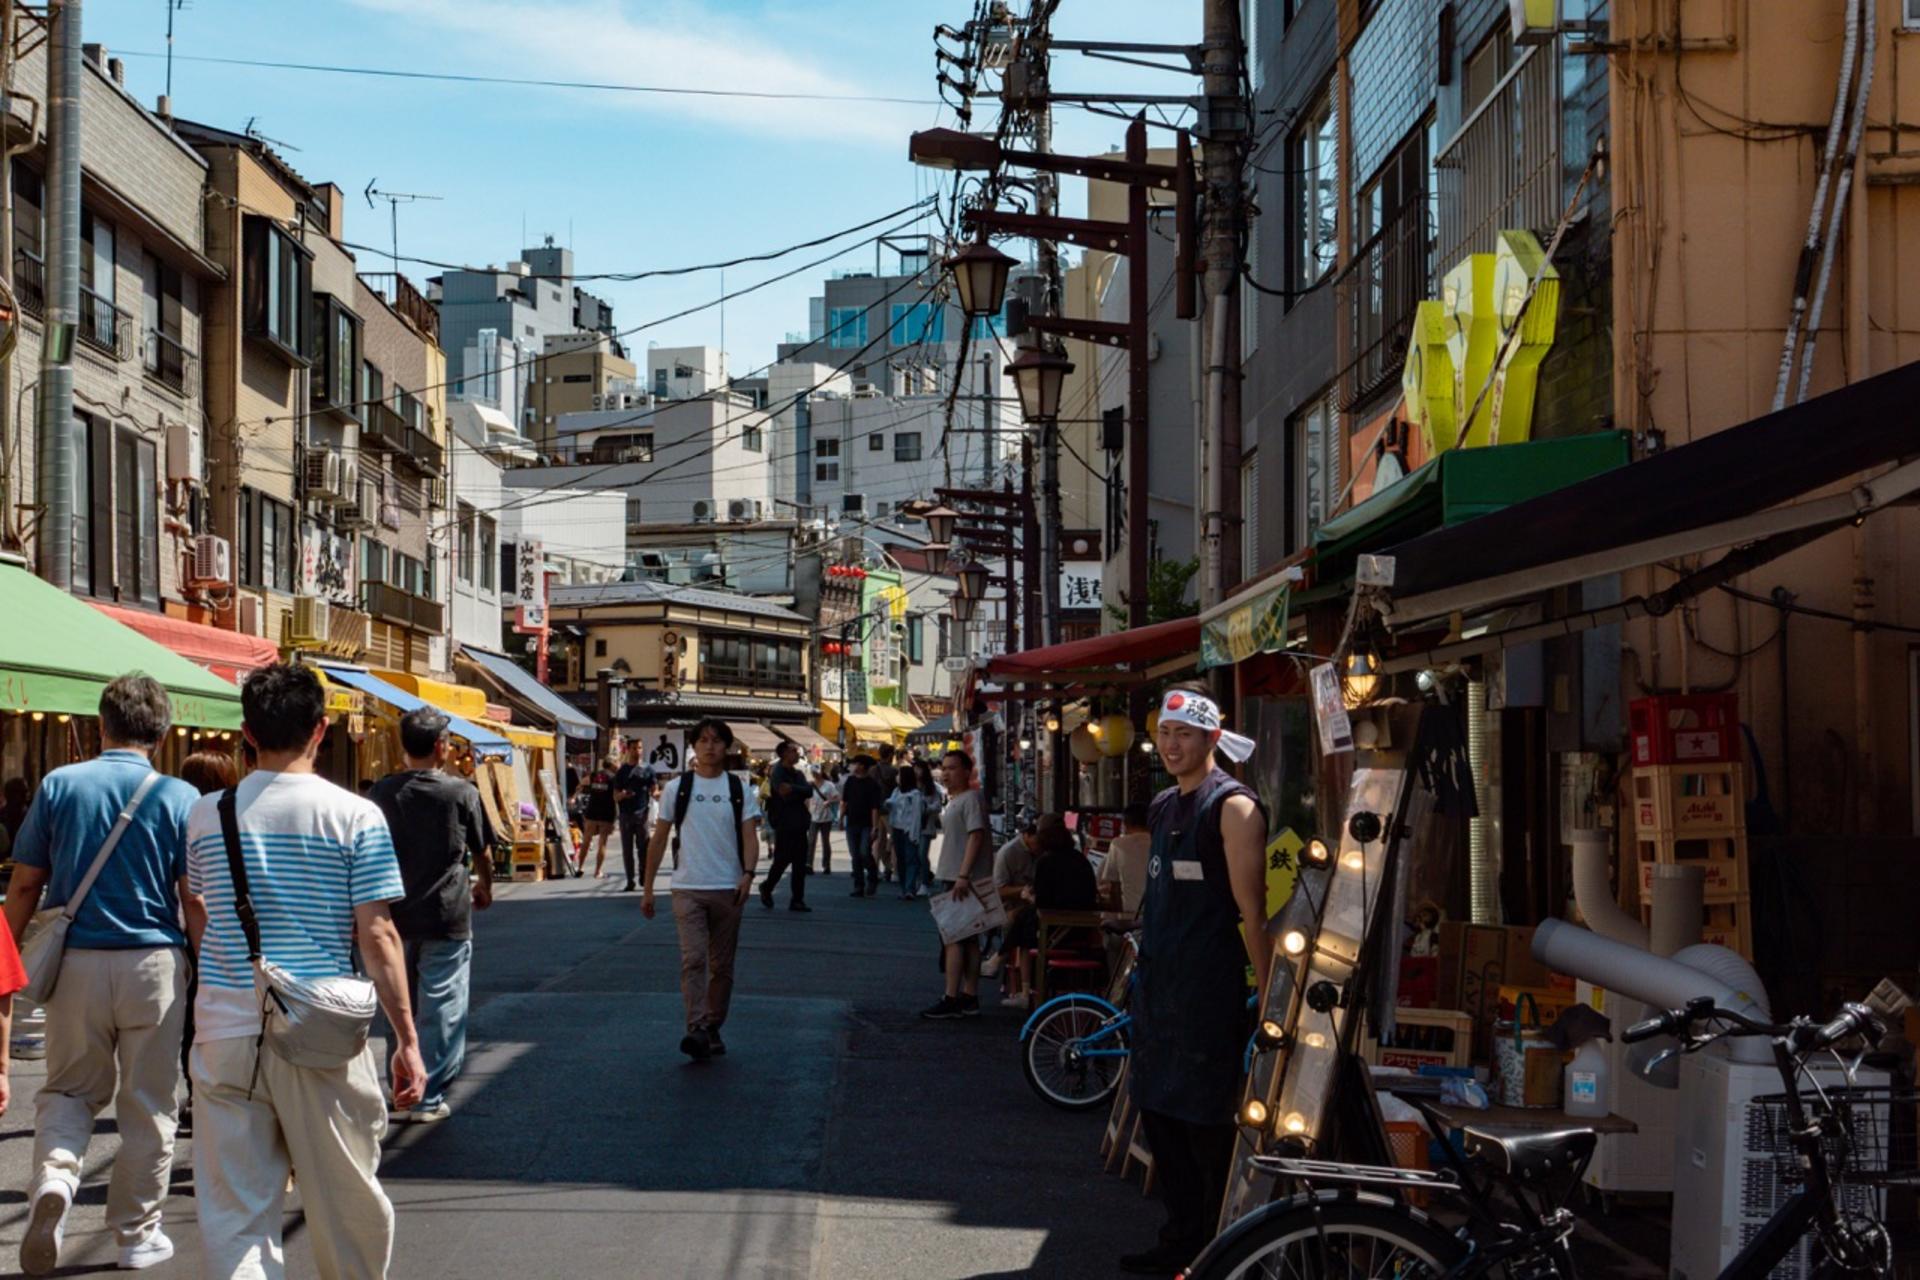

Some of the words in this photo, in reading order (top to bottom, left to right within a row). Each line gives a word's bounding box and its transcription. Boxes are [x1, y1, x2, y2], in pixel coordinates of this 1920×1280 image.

[520, 540, 534, 601] 山加商店
[650, 734, 678, 769] 肉
[1687, 801, 1715, 813] Asahi
[1270, 848, 1292, 871] 鉄
